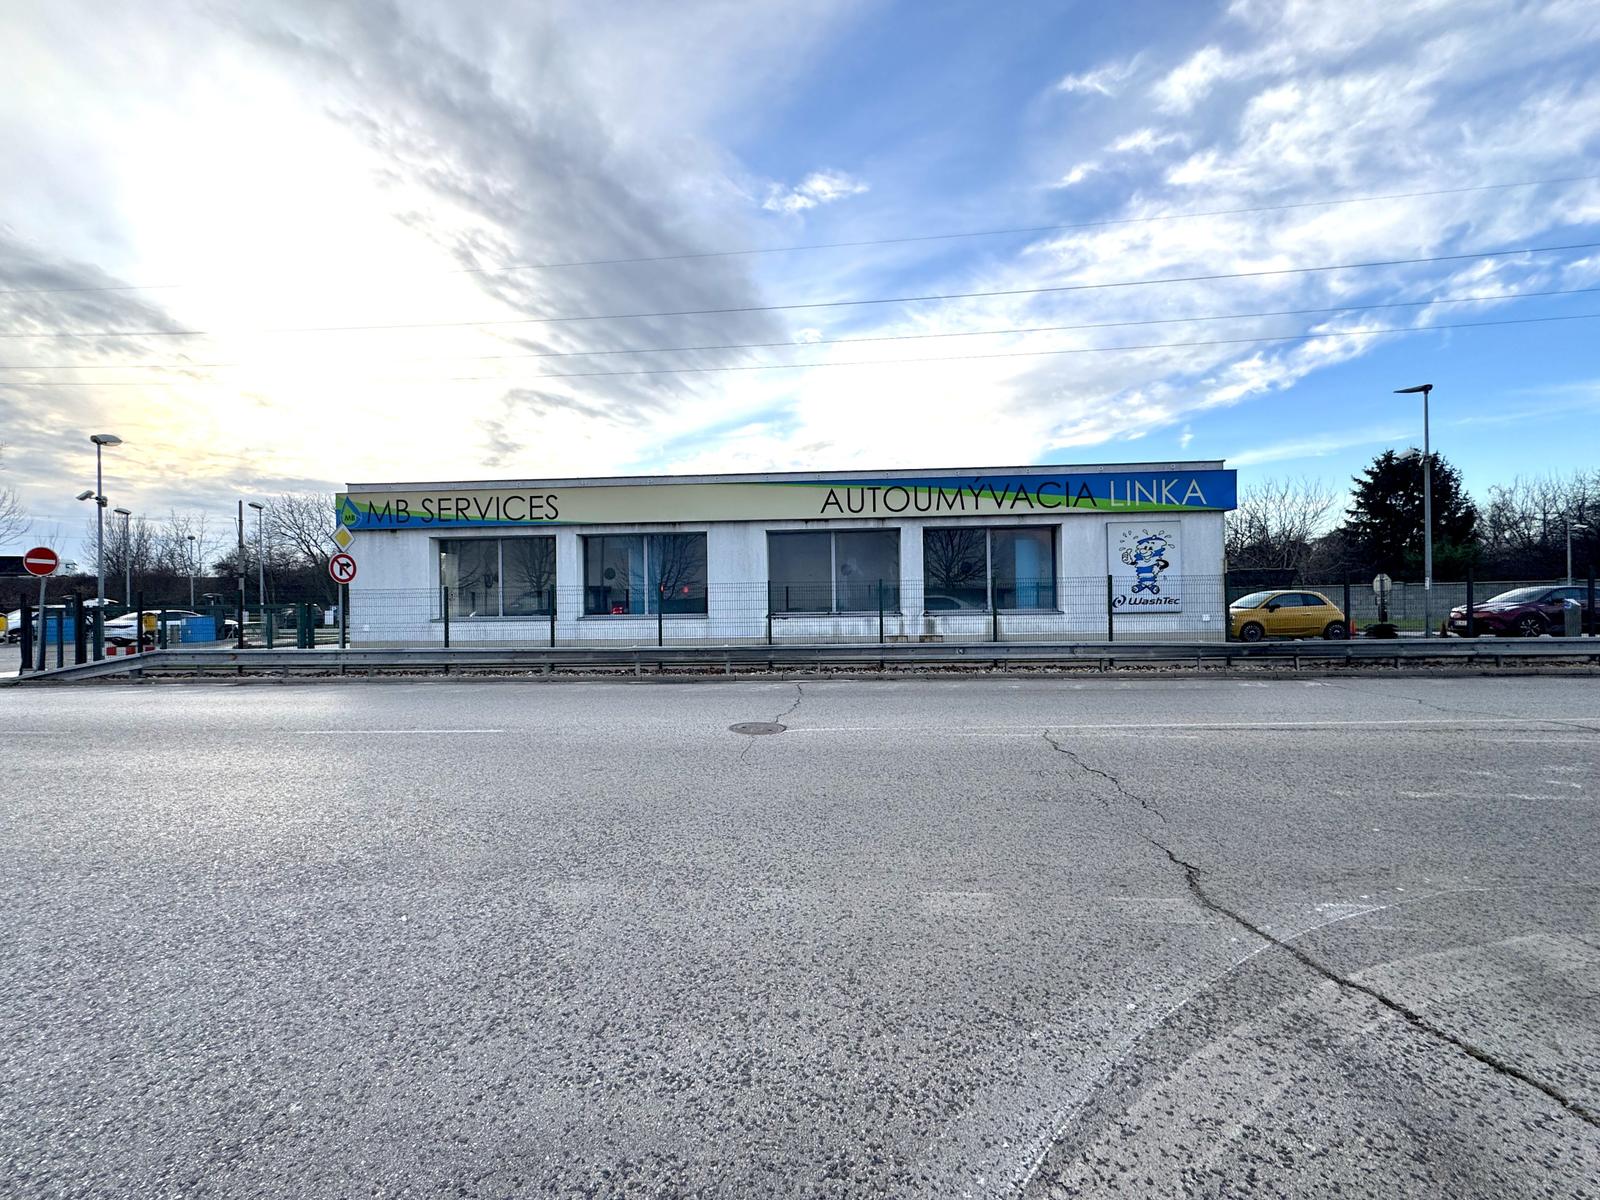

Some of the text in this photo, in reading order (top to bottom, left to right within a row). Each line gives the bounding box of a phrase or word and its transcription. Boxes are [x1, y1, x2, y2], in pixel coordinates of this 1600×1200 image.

[367, 494, 559, 524] MB SERVICES
[820, 476, 1207, 514] AUTOUMÝVACIA LINKA
[1128, 597, 1180, 606] WashTec
